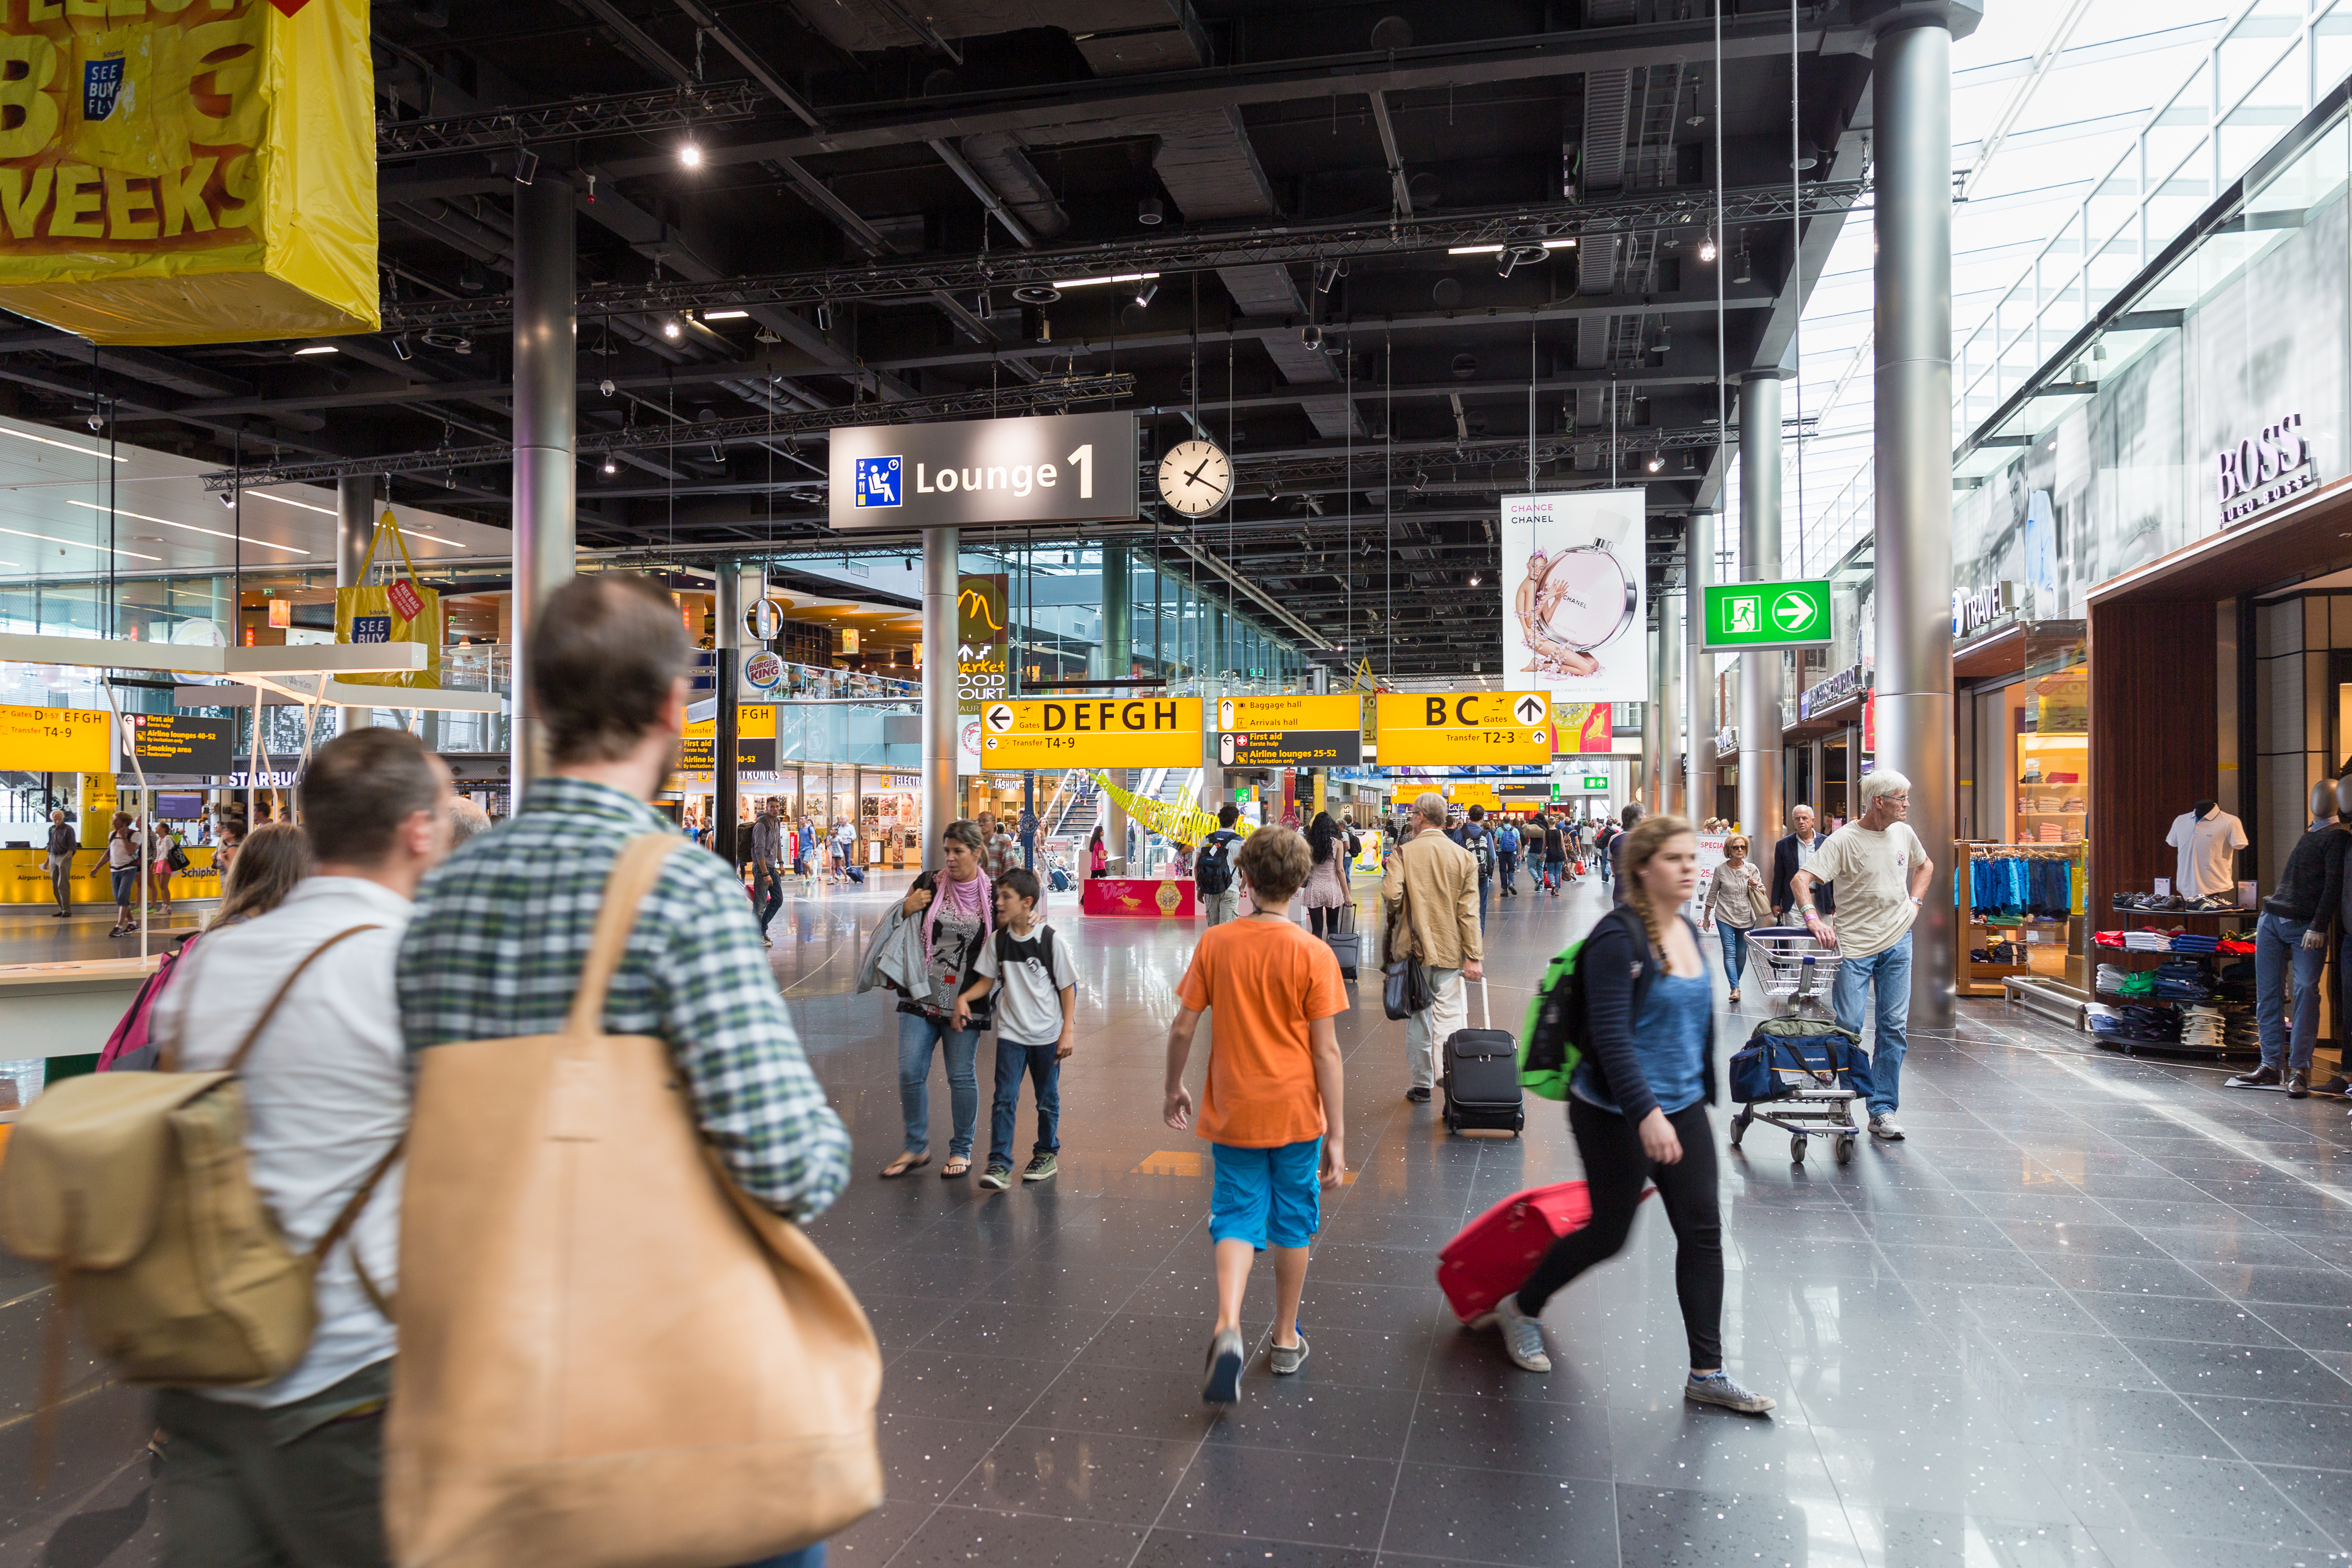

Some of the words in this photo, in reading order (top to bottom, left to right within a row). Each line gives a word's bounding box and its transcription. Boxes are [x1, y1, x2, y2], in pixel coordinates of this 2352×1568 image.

[92, 64, 118, 80] SEE
[89, 80, 117, 98] BUY
[2216, 413, 2301, 505] BOSS
[917, 462, 1058, 497] Lounge
[1067, 444, 1093, 498] 1
[2219, 498, 2254, 525] HUGO
[2263, 475, 2304, 505] BOSS
[1511, 503, 1554, 512] CHANCE
[1511, 516, 1554, 524] CHANEL
[394, 587, 402, 597] WHEN
[404, 602, 415, 615] SPEND
[399, 583, 409, 598] FREE
[408, 596, 420, 610] BAG
[1562, 595, 1587, 609] CHANEL
[1964, 581, 2006, 630] TRAVEL
[359, 620, 385, 632] SEE
[358, 633, 385, 643] BUY
[749, 659, 777, 673] BURGER
[958, 659, 1006, 674] arket
[750, 666, 779, 681] KING
[958, 674, 1006, 686] OOD
[958, 688, 1006, 700] OURT
[43, 727, 72, 737] T4-9
[170, 731, 196, 740] lounges
[1483, 732, 1514, 744] T2-3
[1045, 737, 1075, 748] T4-9
[147, 745, 176, 754] Smoking
[1279, 750, 1312, 758] lounges
[228, 771, 301, 787] STARBUC
[995, 780, 1020, 790] FASHION
[181, 867, 217, 879] Schiphol
[1101, 882, 1132, 900] Dive
